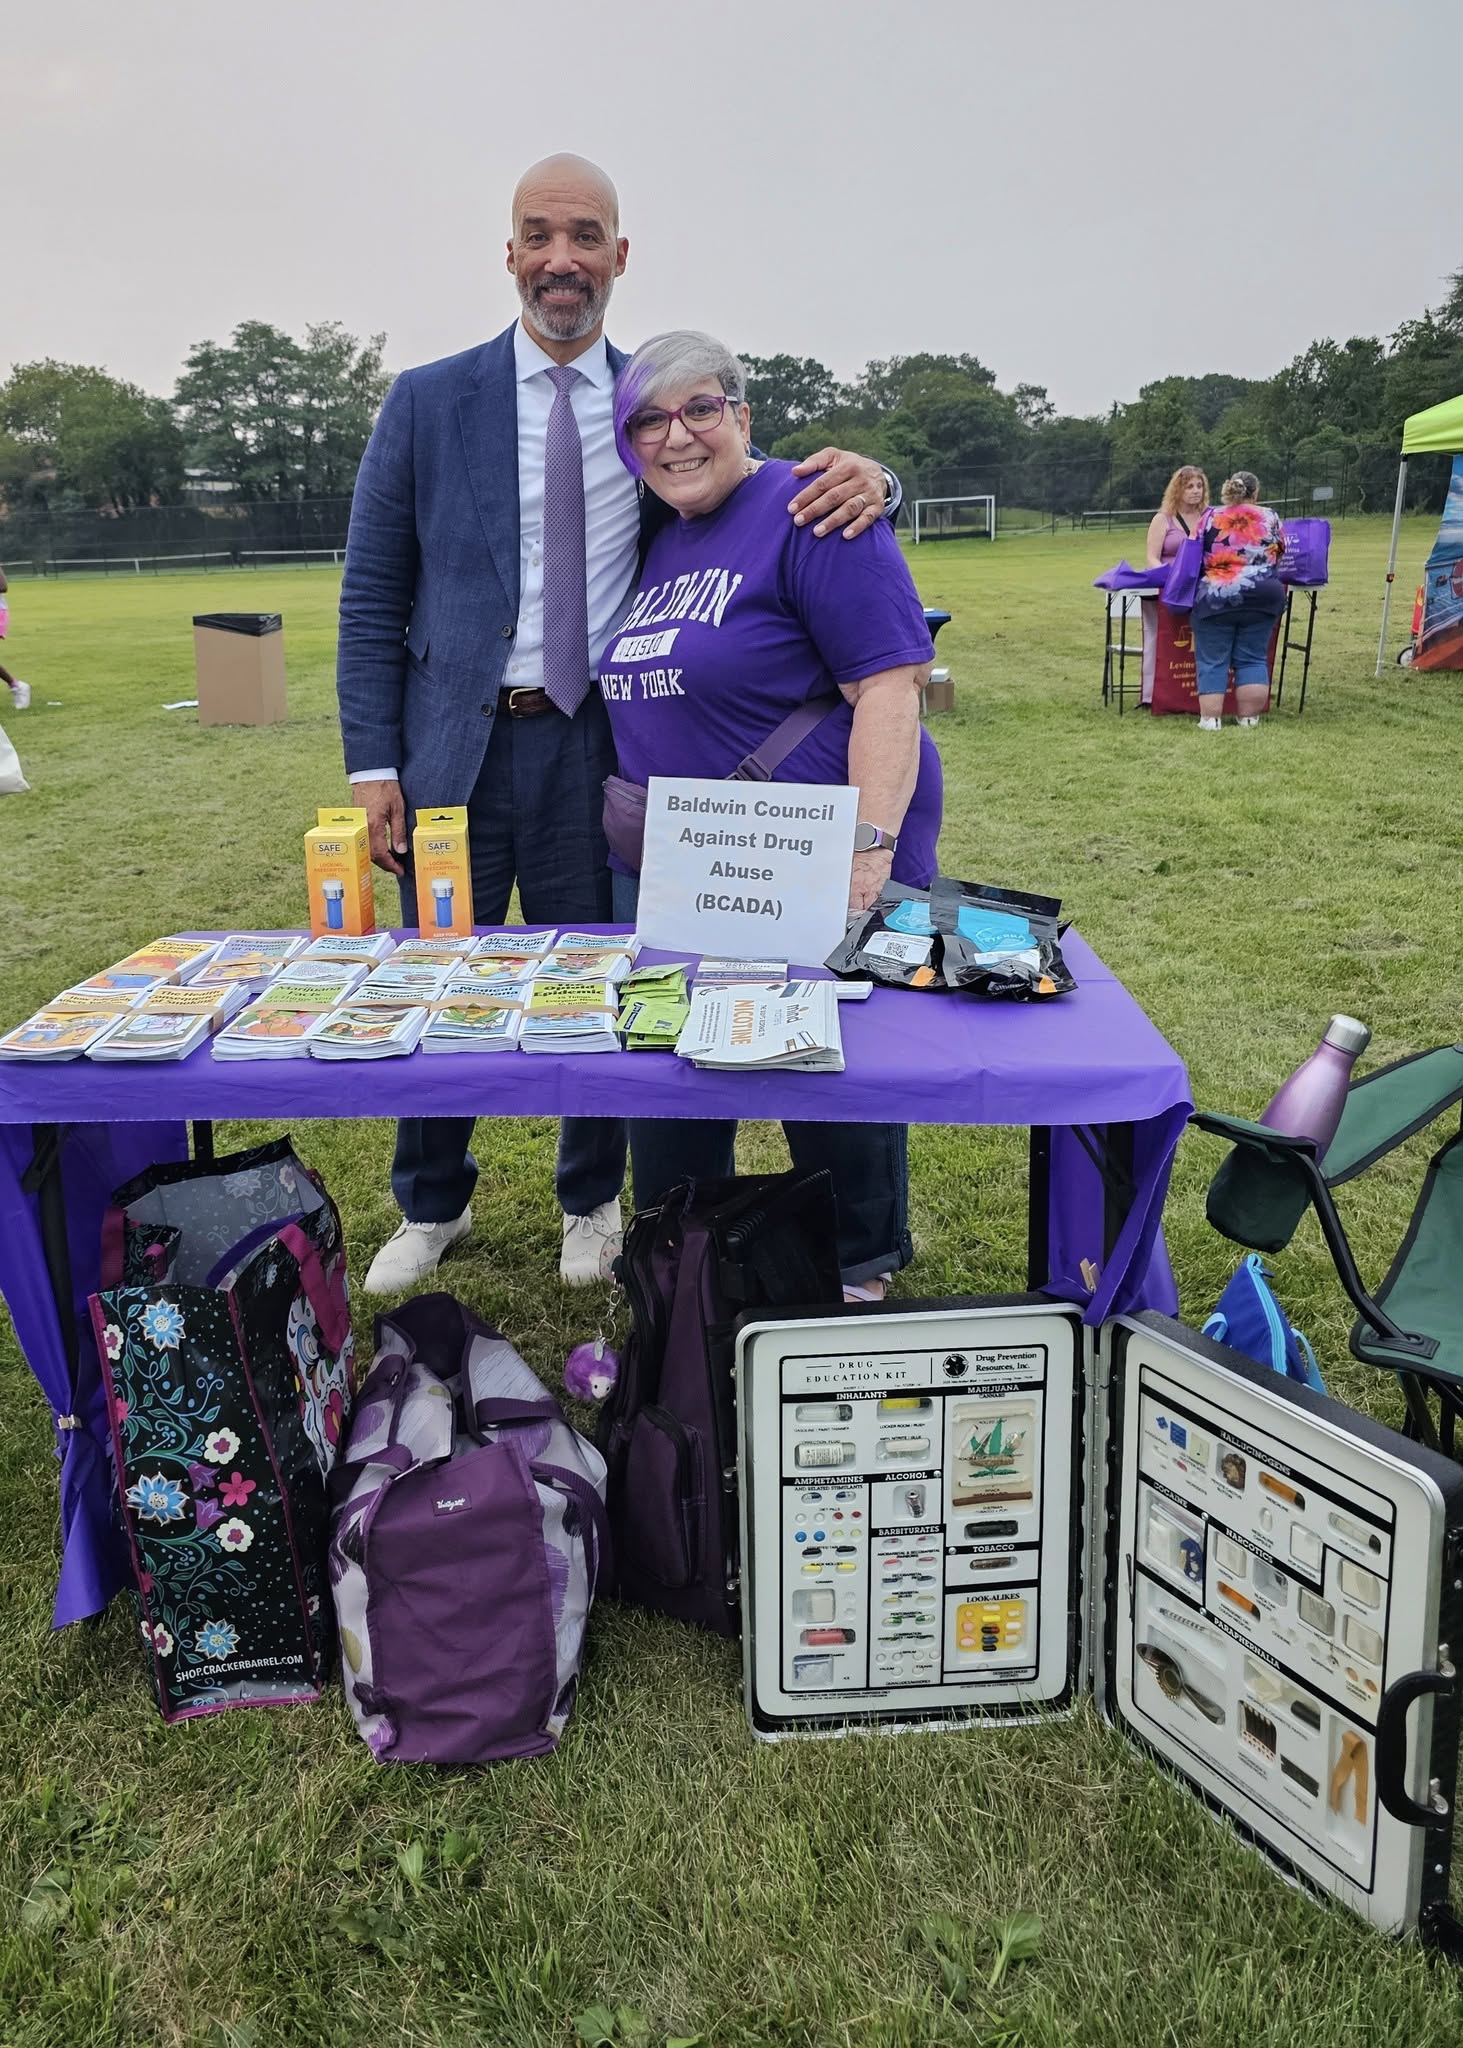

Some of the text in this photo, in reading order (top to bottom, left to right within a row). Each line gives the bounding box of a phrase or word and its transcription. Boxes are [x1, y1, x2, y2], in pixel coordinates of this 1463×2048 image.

[625, 633, 664, 657] 11510
[601, 669, 685, 700] NEW YORK
[667, 795, 835, 821] Baldwin Council
[428, 842, 451, 850] SAFE
[678, 827, 813, 856] Against Drug
[318, 844, 341, 852] SAFE
[709, 860, 774, 881] Abuse
[695, 892, 783, 920] (BCADA)
[511, 939, 546, 947] Adults
[149, 993, 225, 1002] Consequences
[183, 989, 221, 997] Health
[533, 989, 605, 997] Epidemic
[730, 999, 754, 1045] NICOTINE
[976, 1352, 1037, 1363] Drug Prevention
[839, 1360, 873, 1369] DRUG
[976, 1363, 1015, 1372] Resources,
[806, 1371, 907, 1383] EDUCATION KIT
[967, 1384, 1019, 1394] MARIJUANA
[836, 1391, 888, 1400] INHALANTS
[1219, 1430, 1291, 1476] HALLUCINOGENS
[794, 1476, 864, 1485] AMPHETAMINES
[885, 1472, 927, 1481] ALCOHOL
[1153, 1481, 1188, 1508] COCAINE
[878, 1525, 940, 1536] BARBITURATES
[973, 1544, 1015, 1553] TOBACCO
[1225, 1528, 1274, 1564] NARCOTICS
[966, 1592, 1020, 1603] LOOK-ALIKES
[1214, 1617, 1281, 1670] PARAPHERNALIA
[175, 1655, 303, 1683] SHOP.CRACKERBARREL.COM
